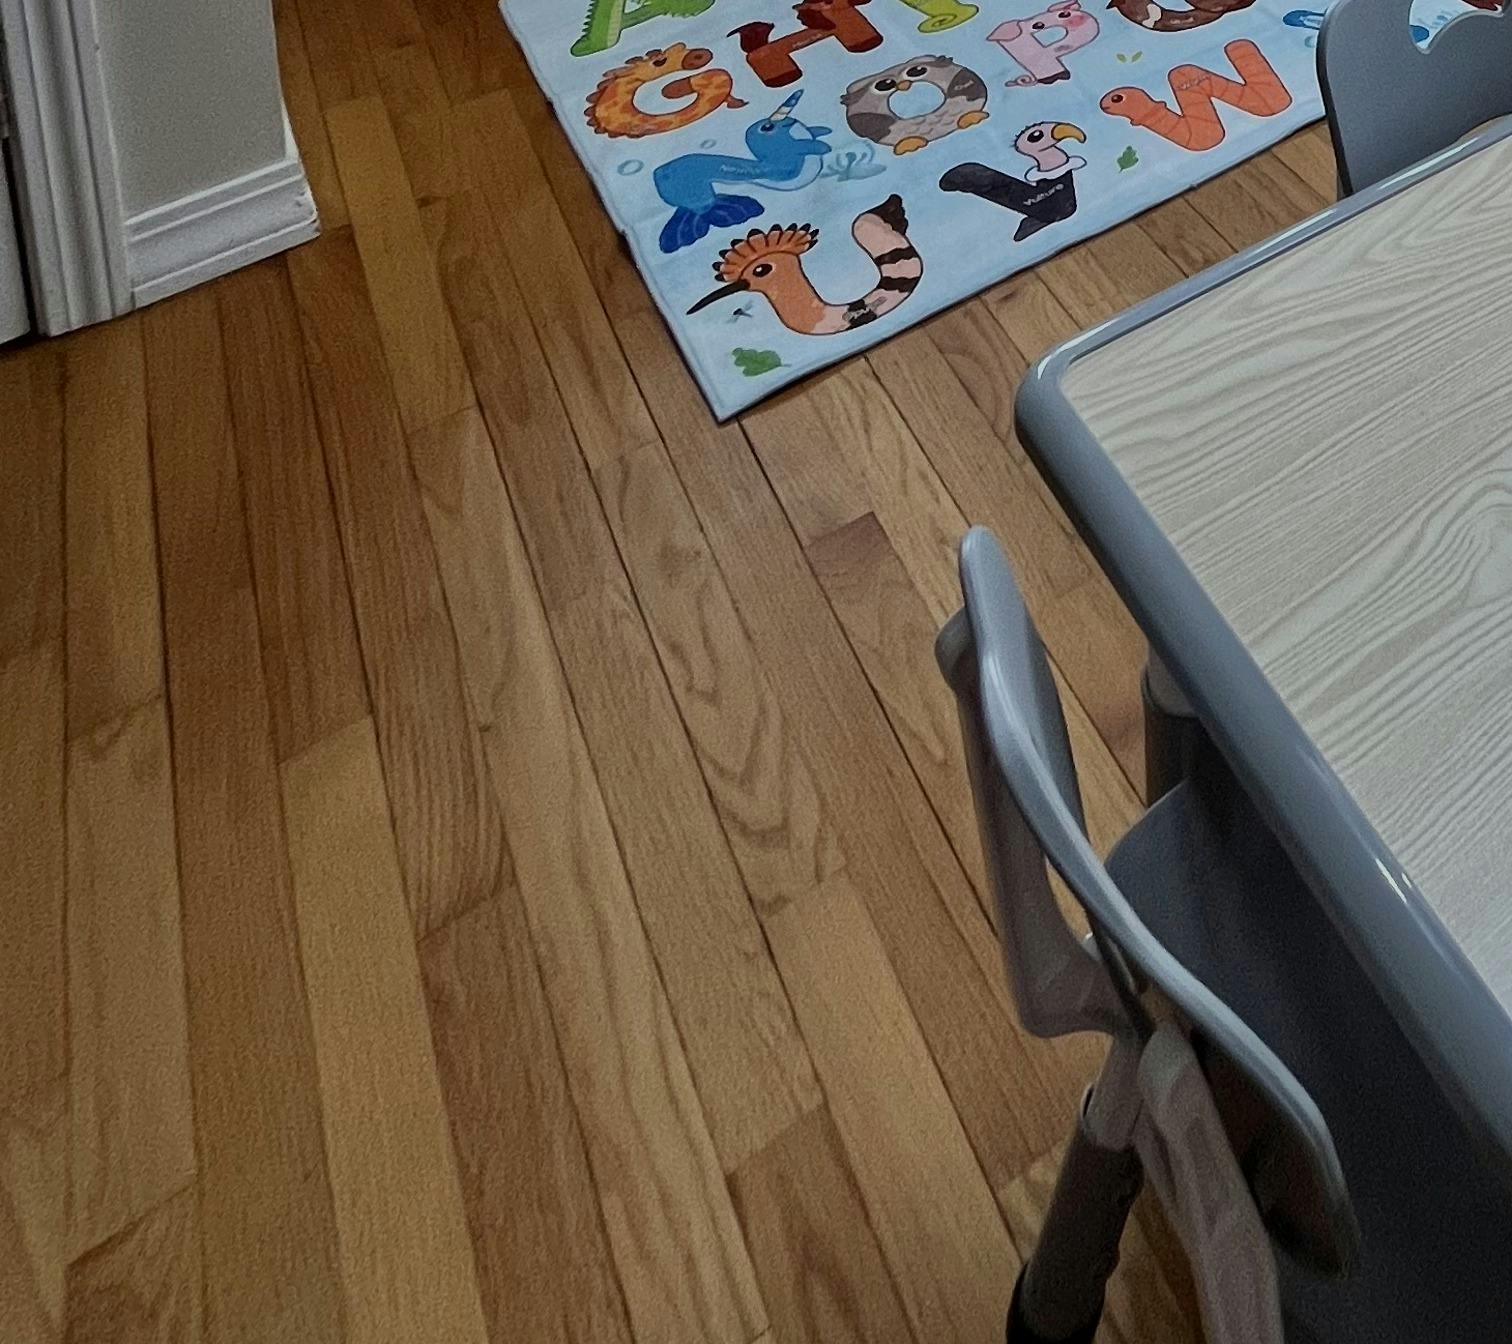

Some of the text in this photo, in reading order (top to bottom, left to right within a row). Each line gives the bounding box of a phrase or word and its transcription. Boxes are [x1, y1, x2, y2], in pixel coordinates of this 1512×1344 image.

[584, 43, 749, 138] G
[841, 55, 989, 155] O
[1099, 39, 1292, 151] W
[1023, 183, 1064, 206] Vulture
